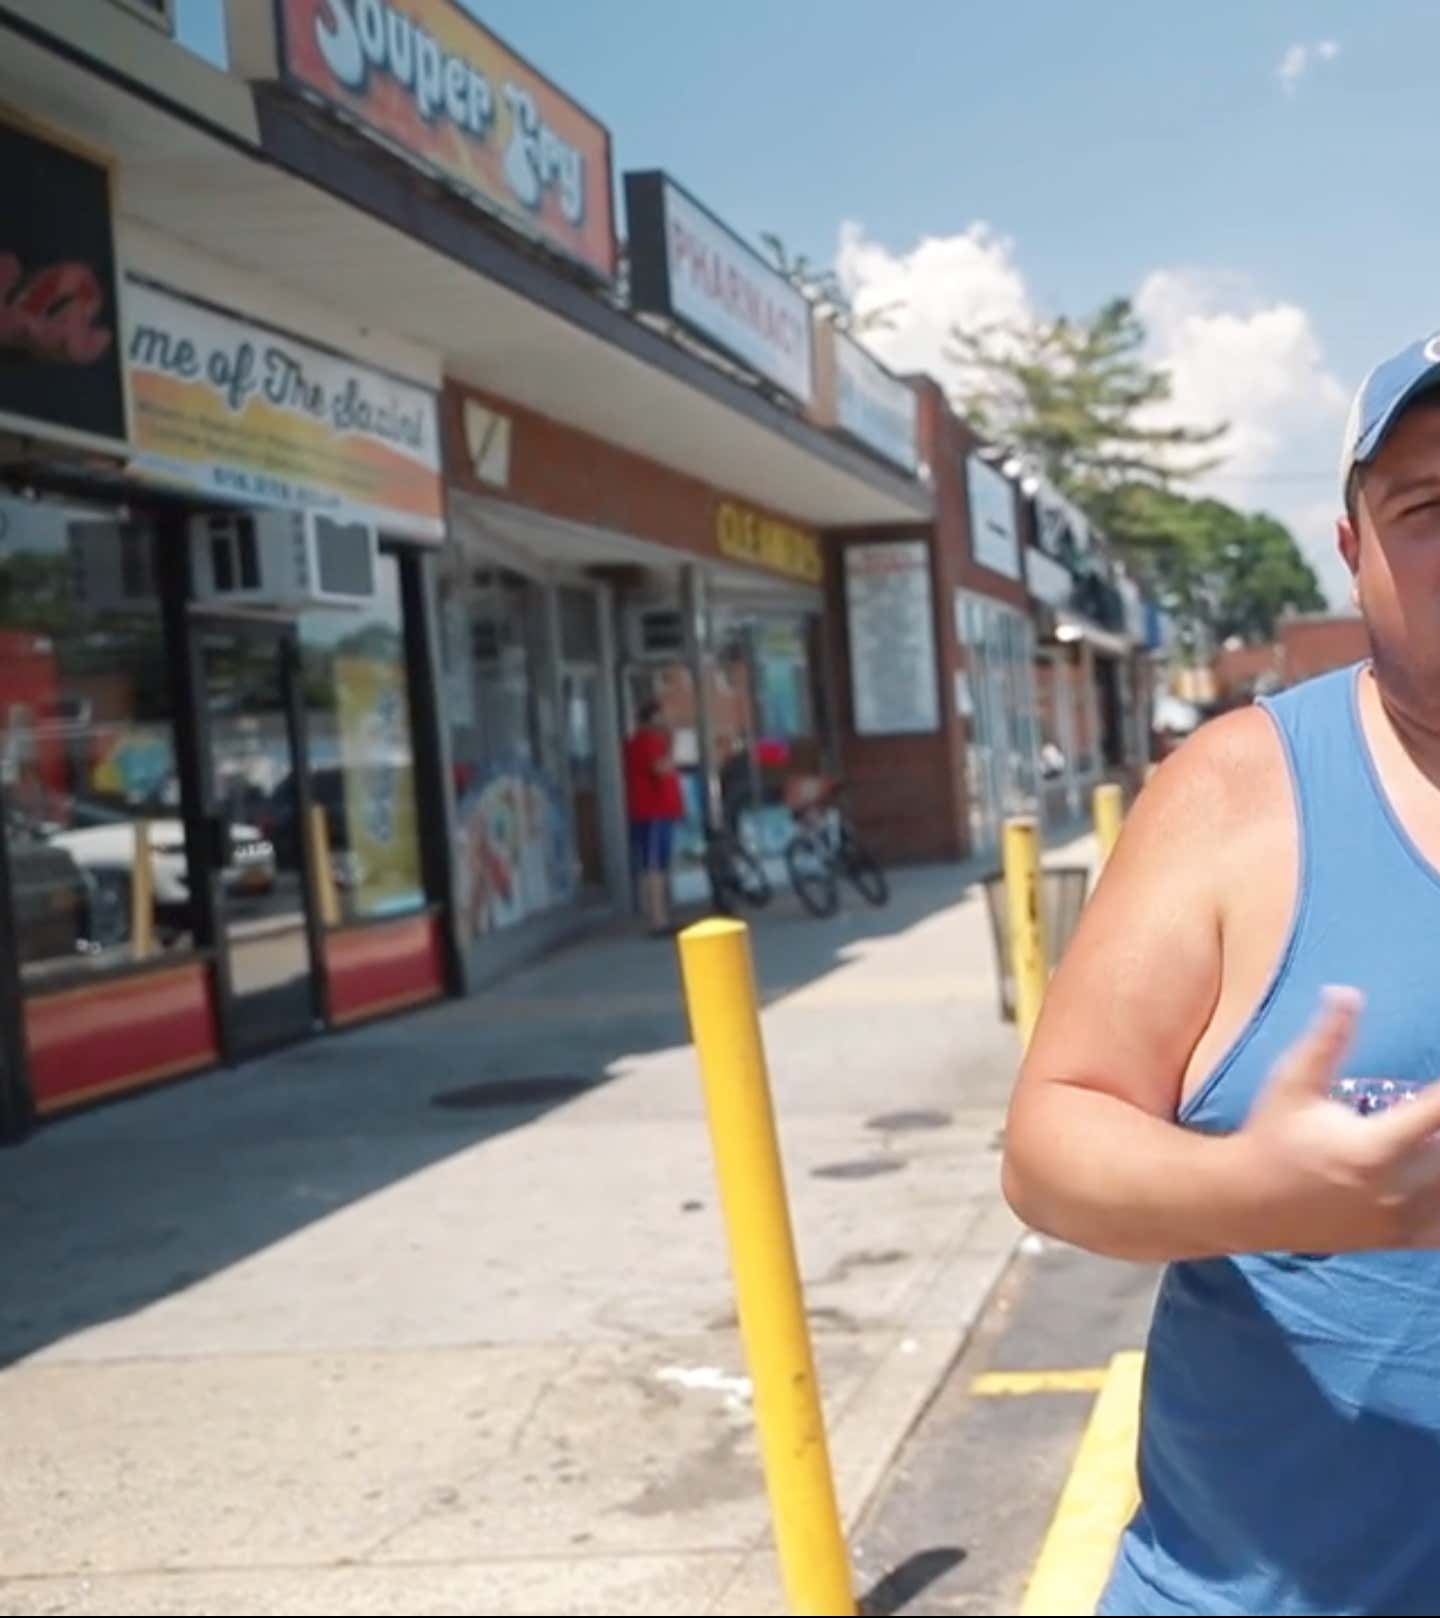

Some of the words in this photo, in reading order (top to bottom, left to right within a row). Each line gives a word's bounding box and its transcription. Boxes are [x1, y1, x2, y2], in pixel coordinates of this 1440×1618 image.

[314, 0, 493, 136] Souper
[670, 217, 806, 356] PHARMACY
[206, 342, 255, 409] of
[263, 346, 324, 416] The
